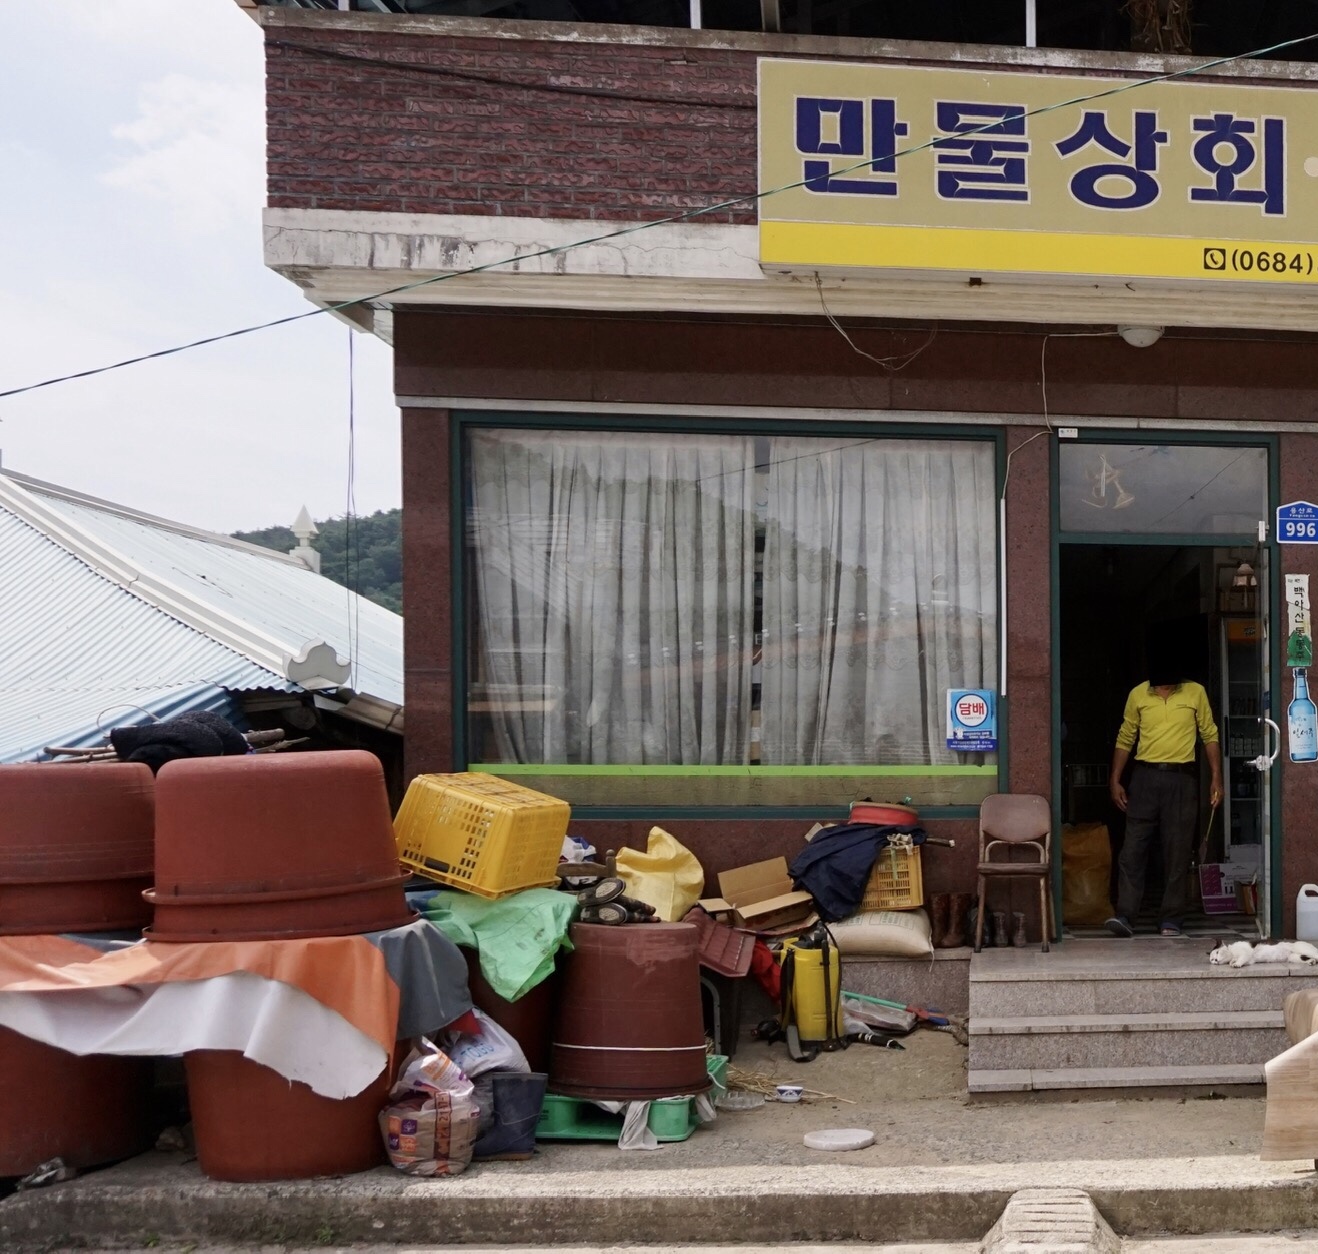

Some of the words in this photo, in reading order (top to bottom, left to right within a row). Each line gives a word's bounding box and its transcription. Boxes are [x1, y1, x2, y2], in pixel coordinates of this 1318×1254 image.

[796, 96, 1287, 217] 만물상회
[1285, 522, 1316, 537] 996
[959, 702, 985, 715] 담배
